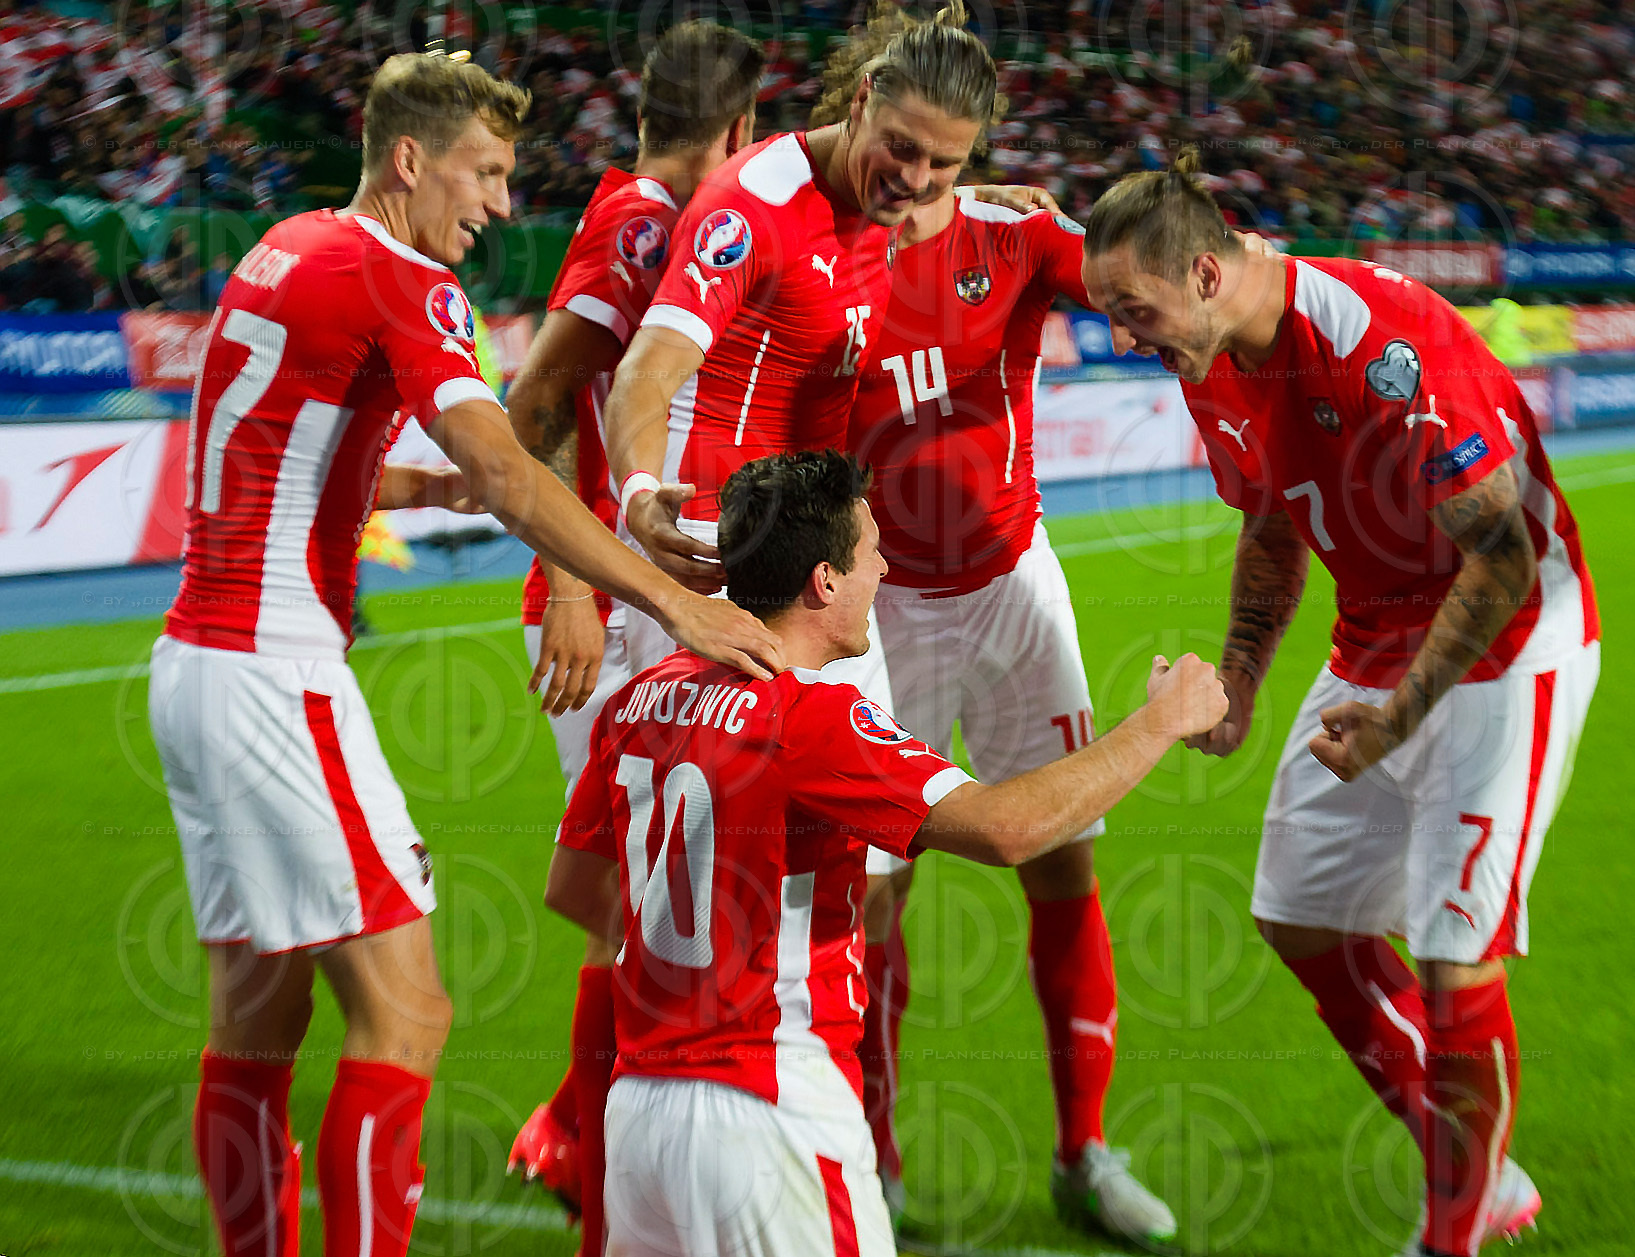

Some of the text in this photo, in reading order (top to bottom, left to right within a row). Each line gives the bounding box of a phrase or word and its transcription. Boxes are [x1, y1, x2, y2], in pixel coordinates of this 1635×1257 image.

[880, 346, 954, 426] 14
[1282, 479, 1337, 552] 7
[615, 753, 715, 969] 10
[1458, 809, 1494, 893] 7
